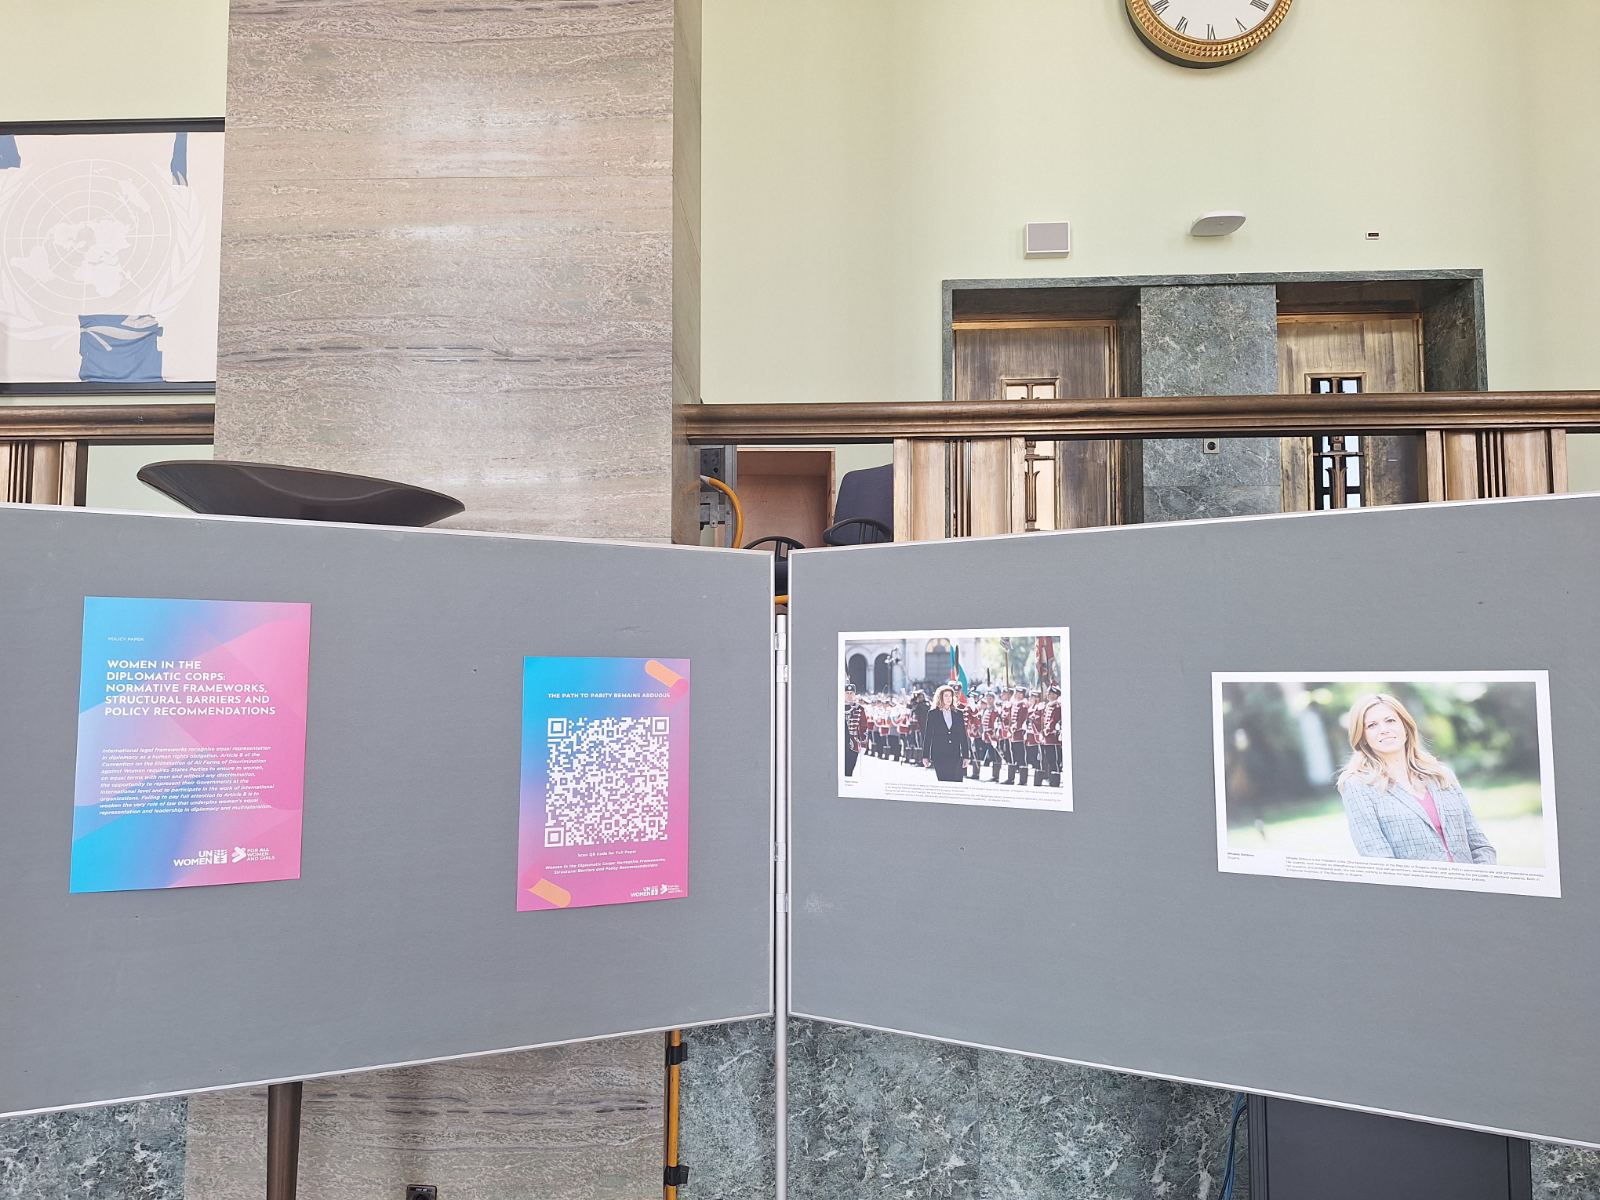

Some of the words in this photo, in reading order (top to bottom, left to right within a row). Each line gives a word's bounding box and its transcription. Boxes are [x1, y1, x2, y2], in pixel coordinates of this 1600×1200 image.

[107, 660, 157, 669] WOMEN
[161, 660, 174, 669] IN
[178, 661, 202, 669] THE
[106, 672, 181, 680] DIPLOMATIC
[185, 672, 226, 681] CORPS:
[106, 684, 179, 692] NORMATIVE
[183, 684, 268, 693] FRAMEWORKS,
[105, 696, 182, 704] STRUCTURAL
[186, 696, 241, 704] BARRIERS
[244, 696, 270, 704] AND
[104, 707, 150, 716] POLICY
[154, 706, 276, 716] RECOMMENDATIONS
[198, 850, 212, 858] UN
[173, 858, 212, 866] WOMEN
